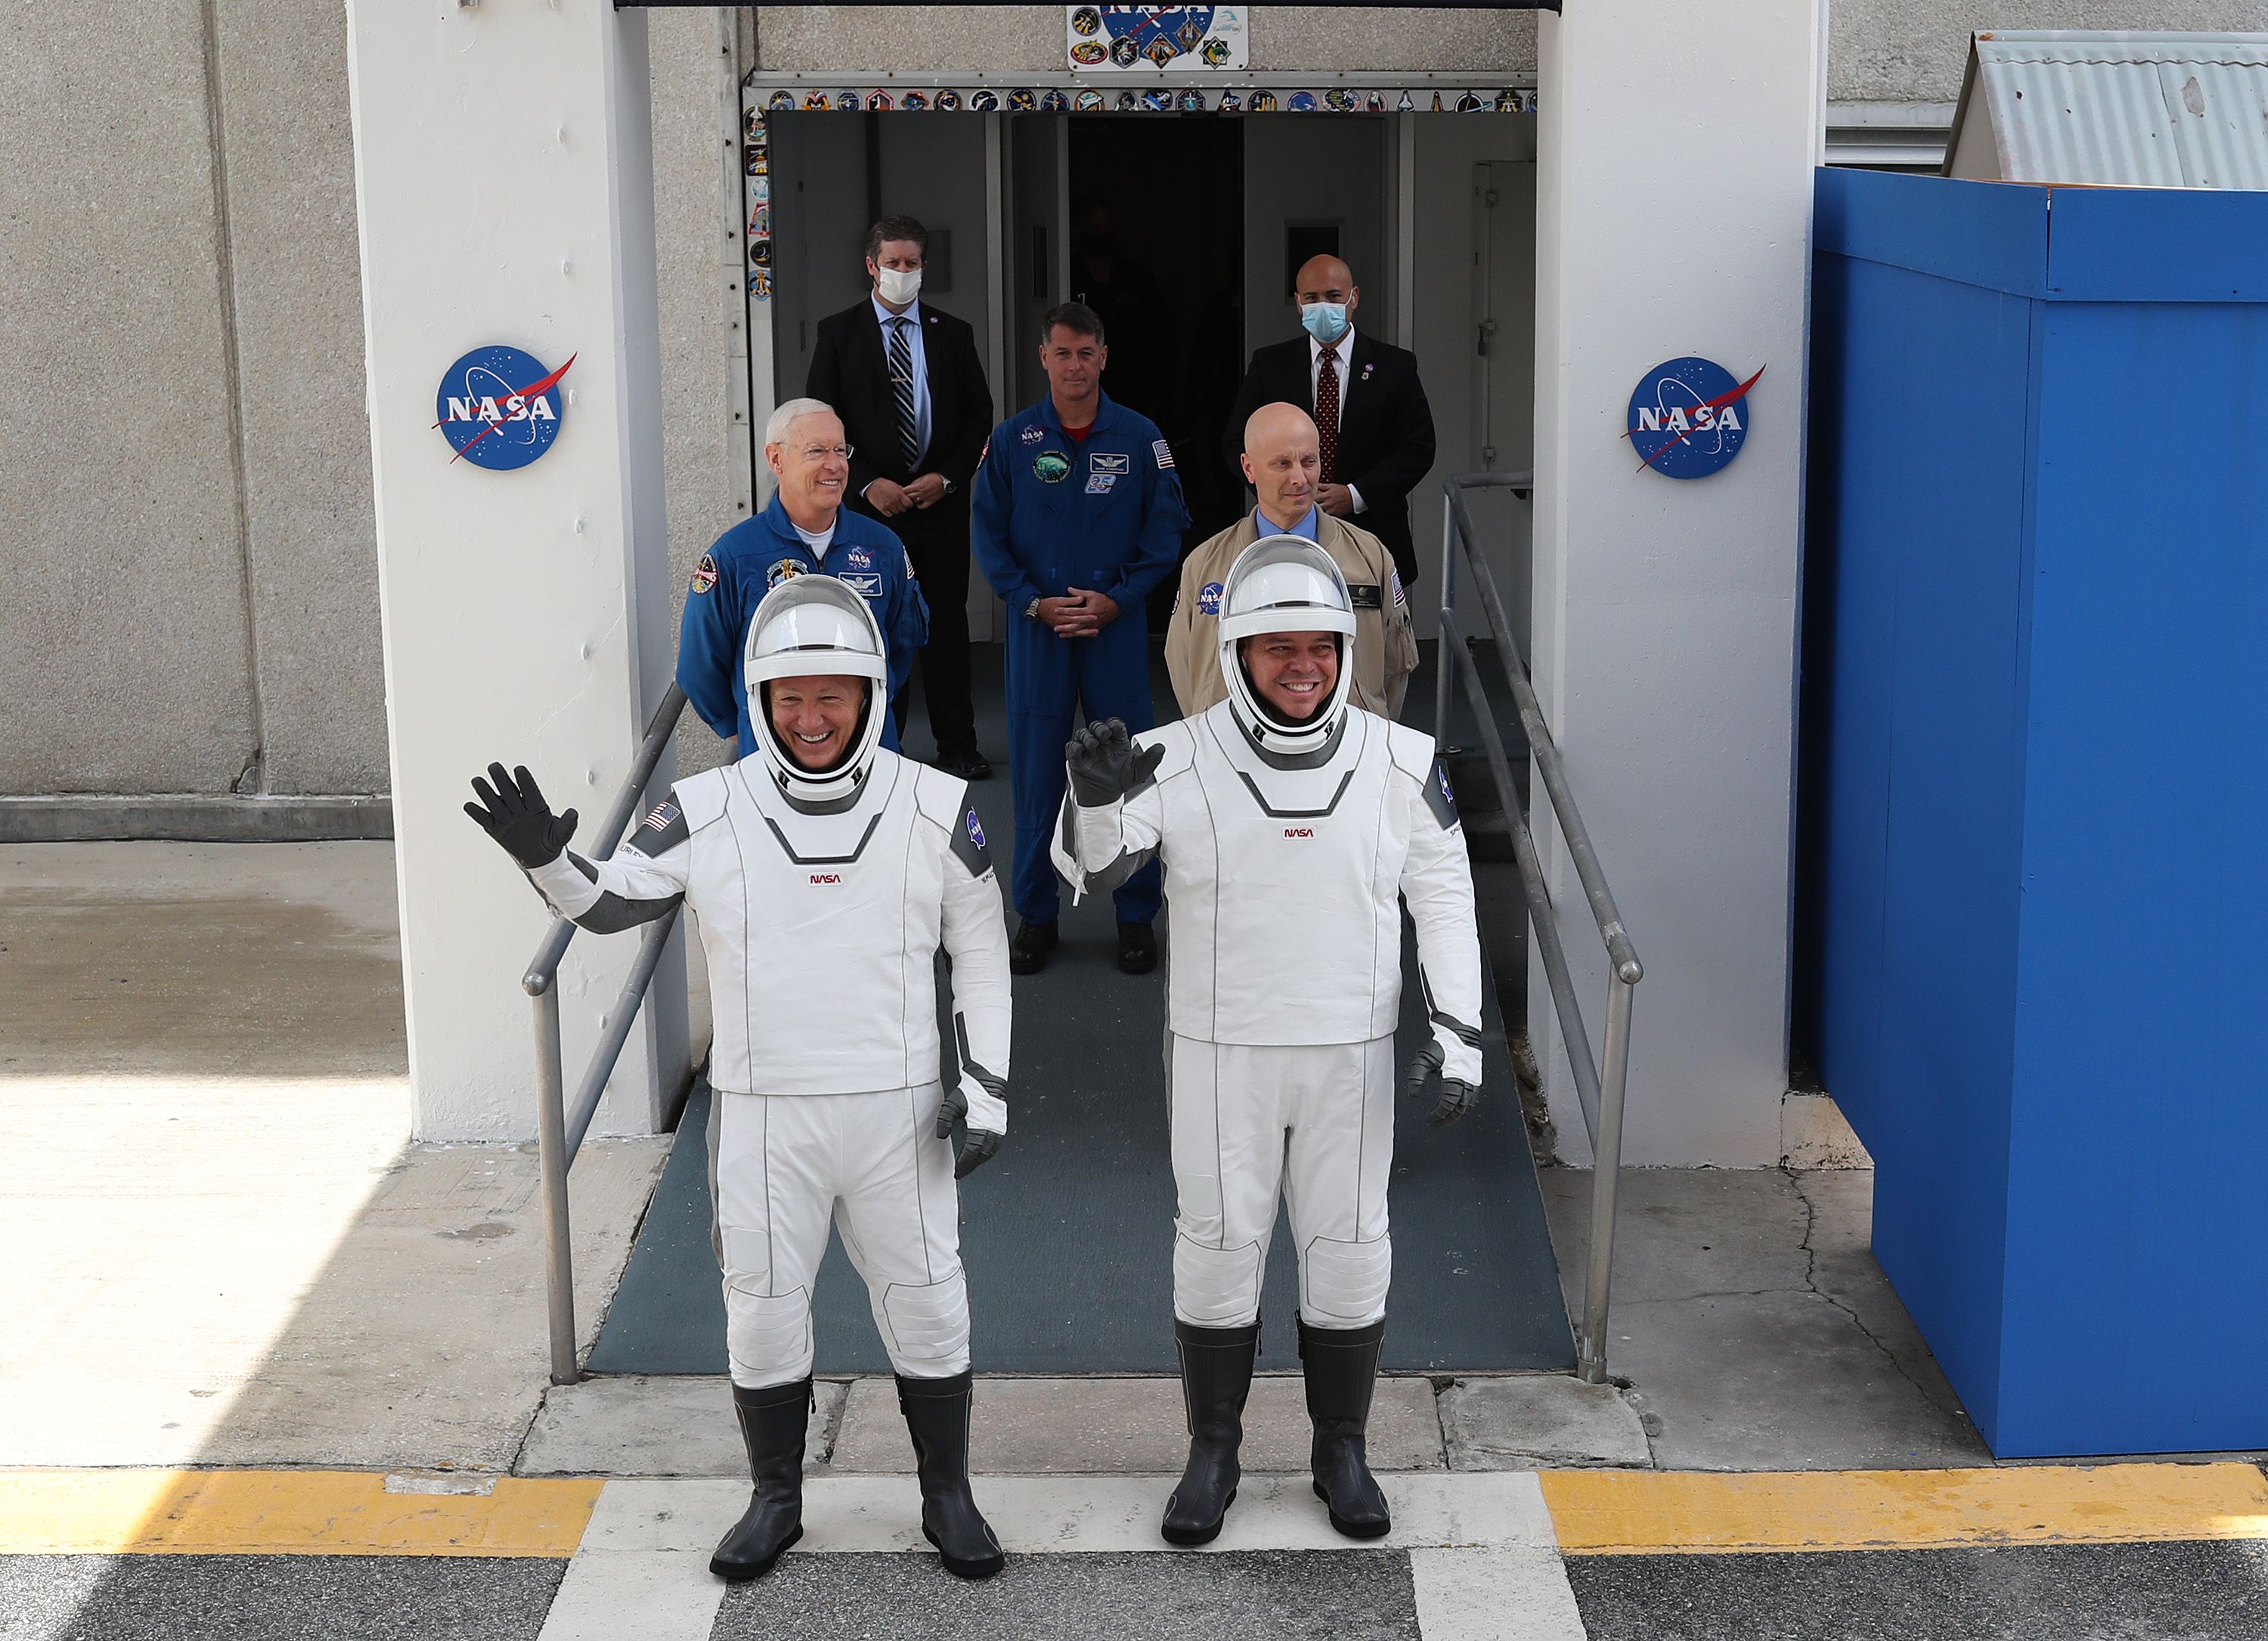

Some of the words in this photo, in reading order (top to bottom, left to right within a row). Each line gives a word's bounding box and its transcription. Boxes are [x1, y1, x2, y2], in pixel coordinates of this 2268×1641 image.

[447, 396, 556, 421] NASA
[1637, 406, 1742, 431] NASA
[1021, 430, 1043, 440] NASA
[847, 554, 871, 563] NASA
[1284, 829, 1314, 837] NASA
[810, 874, 841, 883] NASA
